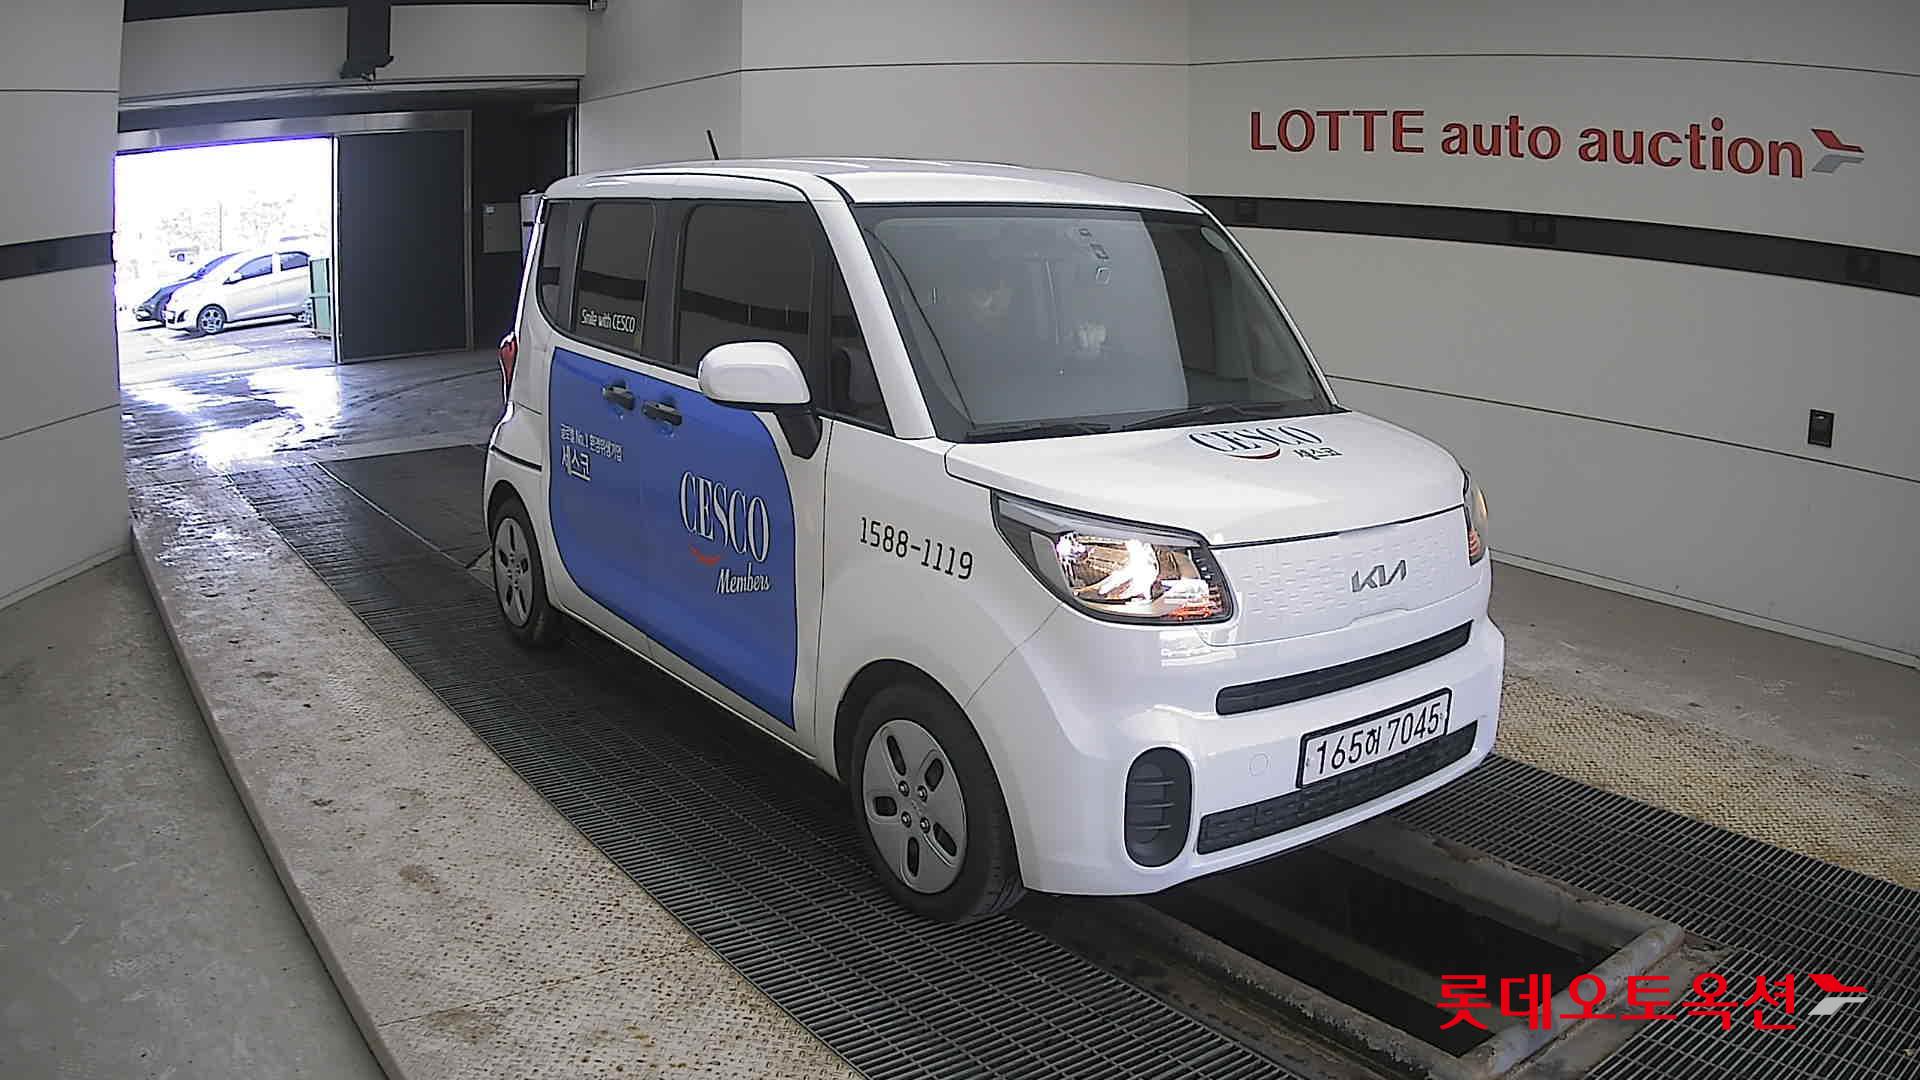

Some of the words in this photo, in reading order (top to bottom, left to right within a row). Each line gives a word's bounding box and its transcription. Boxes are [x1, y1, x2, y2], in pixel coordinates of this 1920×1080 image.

[1250, 110, 1425, 153] LOTTE
[1440, 115, 1562, 161] auto
[1578, 117, 1804, 179] auction
[612, 314, 636, 333] CESCO
[1188, 425, 1323, 452] CESCO
[561, 444, 591, 481] 세스코
[680, 471, 770, 562] CESCO
[859, 516, 974, 580] 1588-1119
[716, 562, 770, 594] Members
[1351, 559, 1407, 592] KIA
[1387, 702, 1441, 752] 7045
